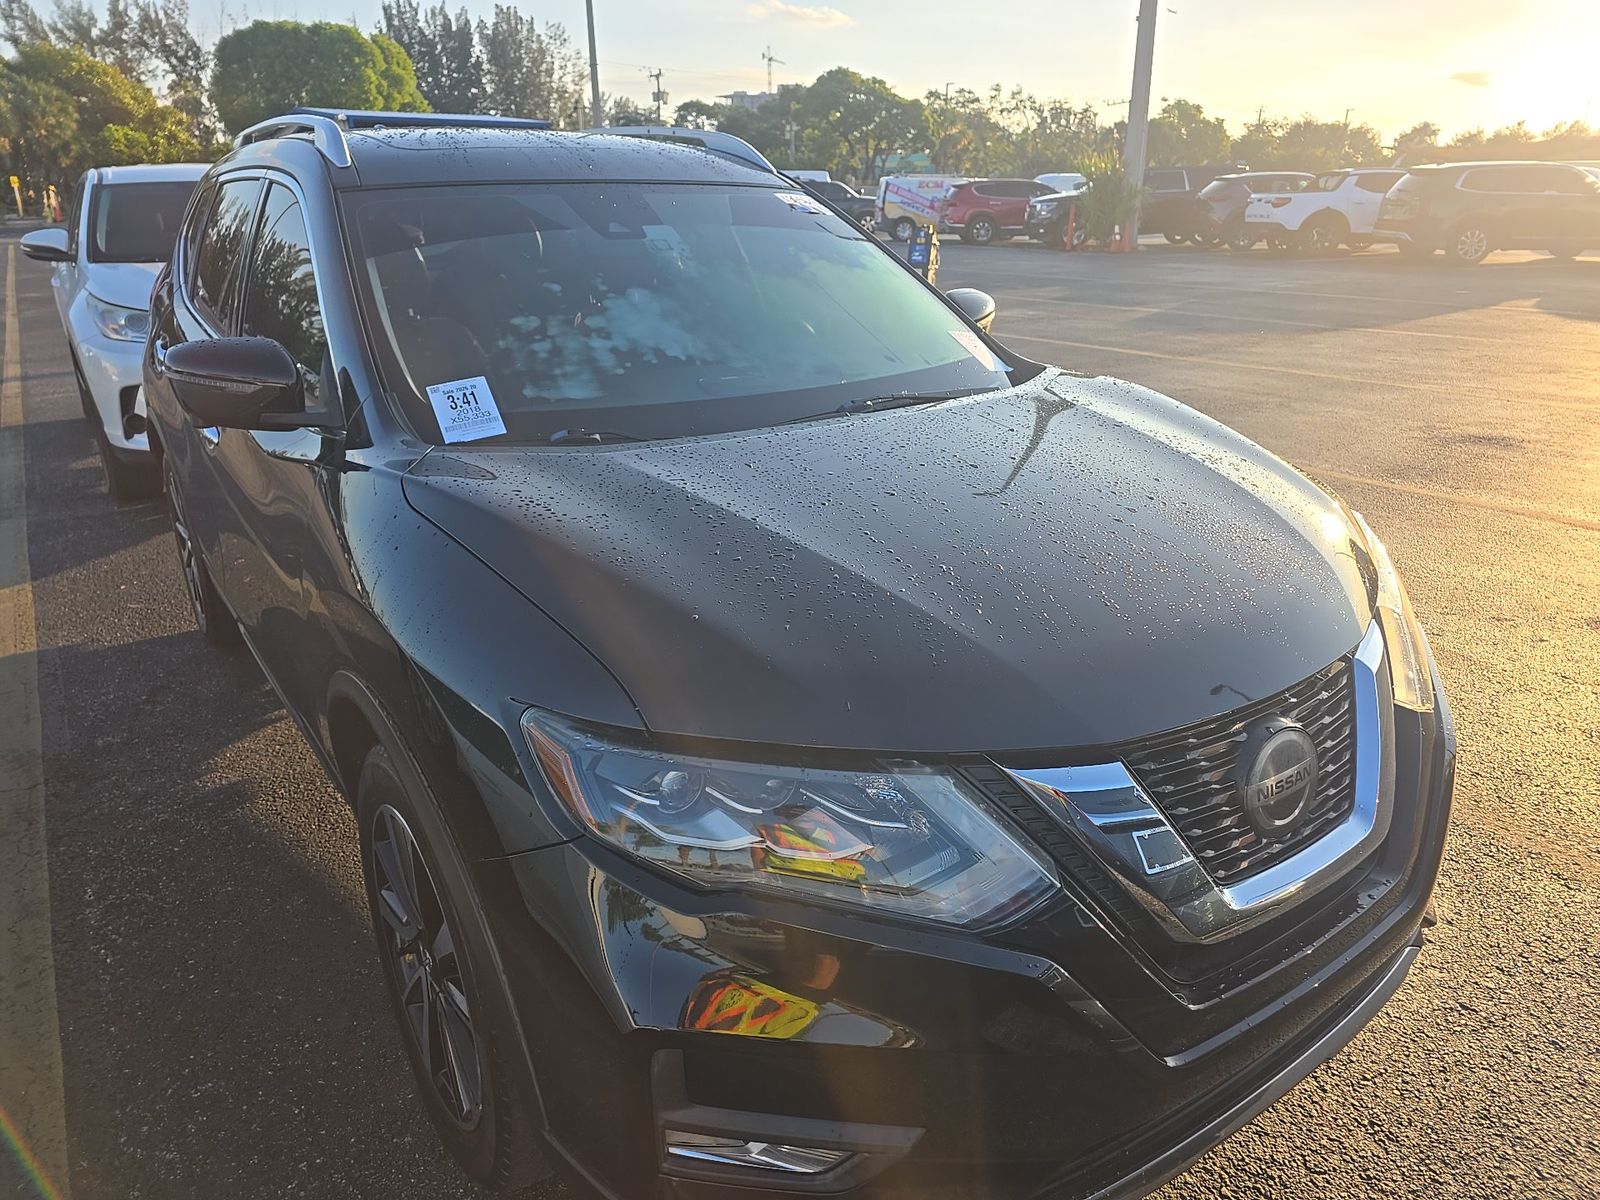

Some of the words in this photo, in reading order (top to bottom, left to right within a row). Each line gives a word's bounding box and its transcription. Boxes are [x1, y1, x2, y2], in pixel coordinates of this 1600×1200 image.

[919, 180, 944, 189] ECM
[442, 388, 454, 396] Sale
[447, 390, 478, 410] 3:41
[456, 405, 482, 416] 2018
[1257, 763, 1312, 802] NISSAN
